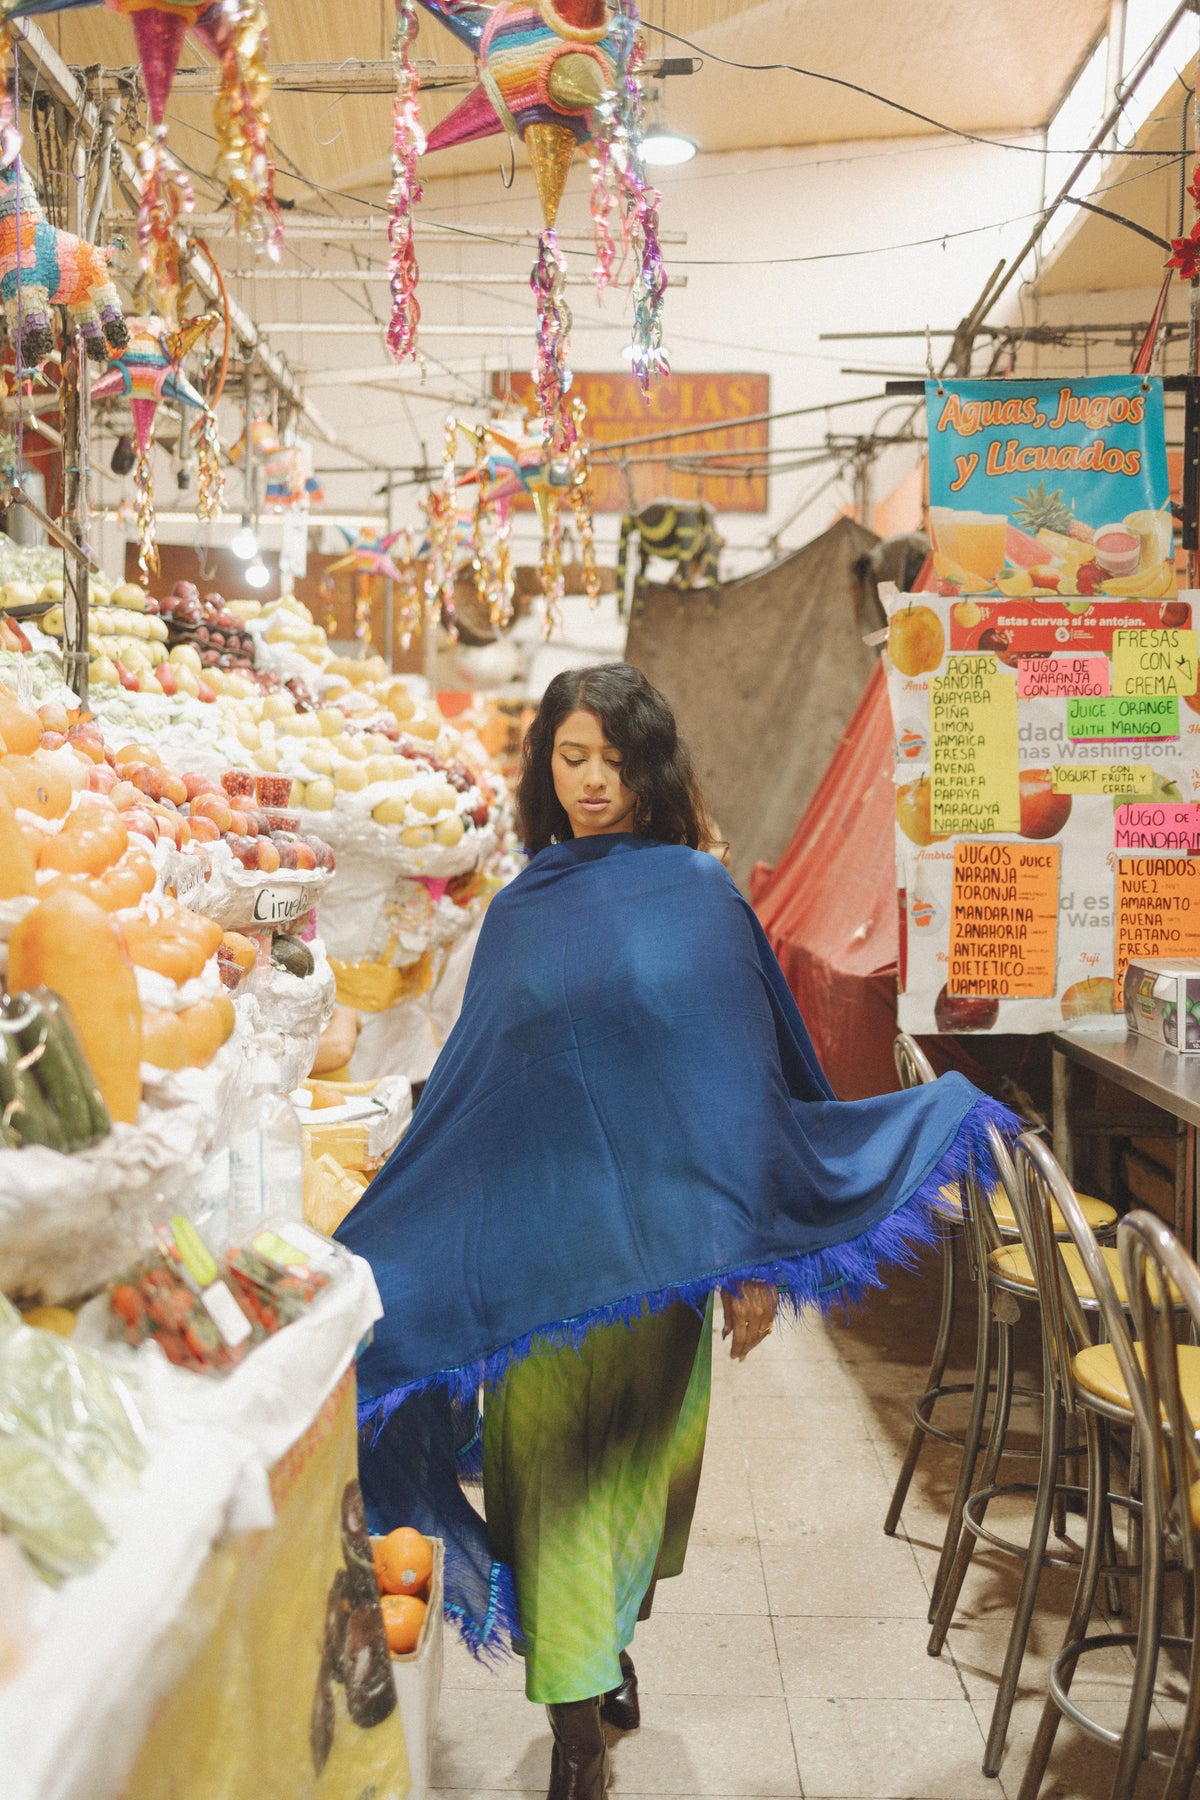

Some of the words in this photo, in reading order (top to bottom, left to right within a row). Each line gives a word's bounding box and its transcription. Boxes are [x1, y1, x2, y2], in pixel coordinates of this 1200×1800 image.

[554, 380, 753, 417] RACIAS
[936, 392, 1046, 436] Aguas,
[1049, 385, 1146, 430] Jugos
[950, 452, 978, 491] y
[985, 439, 1142, 477] Licuados
[997, 616, 1027, 626] Estas
[1030, 617, 1069, 626] curvas
[1071, 615, 1082, 626] sí
[1084, 617, 1097, 626] se
[1099, 616, 1146, 628] antojan.
[1118, 629, 1179, 648] FRESAS
[947, 658, 997, 675] AGUAS
[1023, 660, 1058, 672] JUGO
[1073, 660, 1089, 672] DE
[1140, 652, 1171, 670] CON
[933, 675, 983, 690] SANDIA
[1030, 673, 1090, 683] NARANJA
[1126, 676, 1178, 695] CREMA
[902, 681, 929, 691] Amb
[933, 690, 991, 704] GUAYABA
[935, 705, 969, 718] PIÑA
[1071, 700, 1106, 718] JUICE
[1119, 701, 1174, 716] ORANGE
[1112, 721, 1161, 734] MANGO
[935, 736, 985, 746] JAMAICA
[935, 748, 975, 760] FRESA
[1058, 742, 1183, 761] Washington.
[935, 763, 975, 773] AVENA
[1053, 766, 1098, 782] YOGURT
[1101, 774, 1134, 782] FRUTA
[935, 776, 985, 786] ALFALFA
[935, 789, 979, 800] PAPAYA
[1103, 785, 1138, 794] CEREAL
[1119, 803, 1165, 826] JUGO
[935, 818, 994, 830] NARANJA
[913, 851, 955, 861] Ambro
[959, 846, 1011, 865] JUGOS
[1020, 856, 1052, 867] JUICE
[955, 867, 1017, 883] NARANJA
[1119, 859, 1196, 876] LICUADOS
[955, 886, 1017, 901] TORONJA
[1121, 896, 1190, 911] AMARANTO
[955, 906, 1033, 923] MANDARINA
[1120, 928, 1181, 941] PLATANO
[954, 943, 1025, 959] ANTIGRIPAL
[1119, 943, 1159, 956] FRESA
[1080, 953, 1100, 966] Fuji
[953, 961, 1024, 976] DIETETICO
